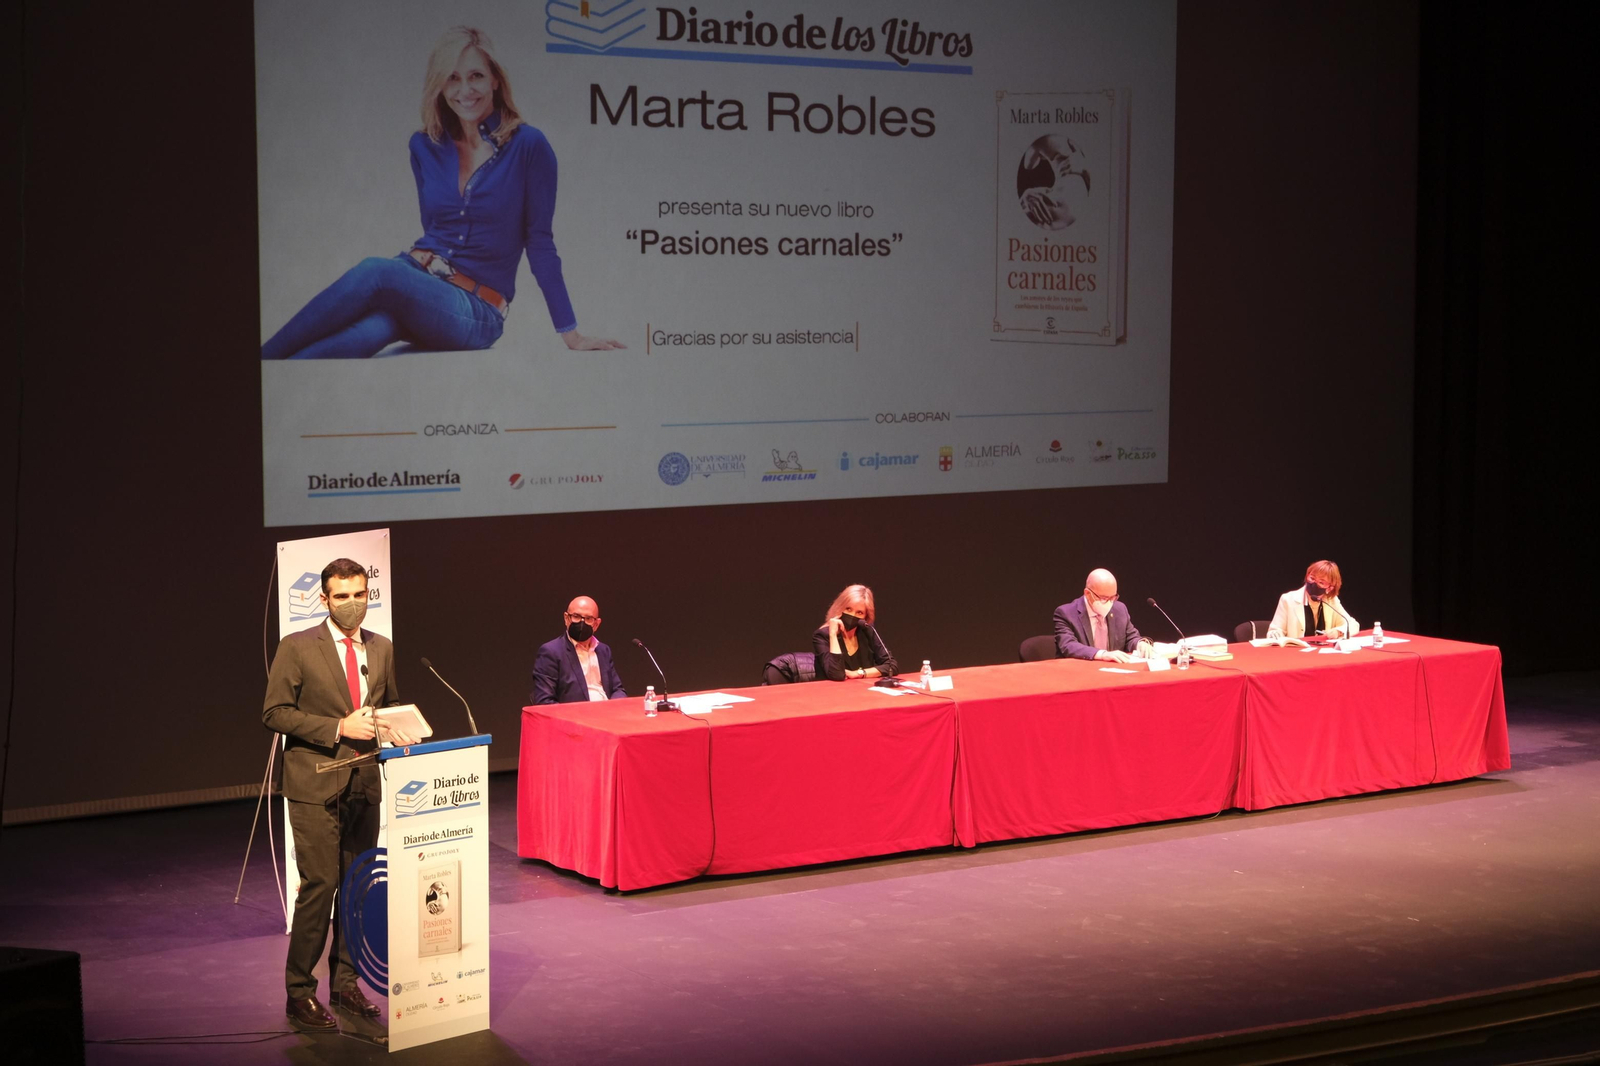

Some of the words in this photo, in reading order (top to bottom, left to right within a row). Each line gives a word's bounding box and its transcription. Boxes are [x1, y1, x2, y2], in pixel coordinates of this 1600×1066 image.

[656, 7, 778, 46] Diario
[782, 14, 827, 50] de
[831, 17, 875, 52] los
[881, 18, 973, 66] Libros
[589, 83, 748, 131] Marta
[766, 91, 936, 138] Robles
[1010, 108, 1050, 124] Marta
[1055, 107, 1099, 124] Robles
[658, 200, 743, 218] presenta
[748, 204, 770, 217] su
[775, 203, 832, 218] nuevo
[837, 201, 874, 218] libro
[626, 229, 769, 256] “Pasiones
[777, 232, 903, 257] carnales”
[1008, 237, 1097, 264] Pasiones
[1007, 266, 1097, 291] carnales
[652, 329, 715, 346] Gracias
[720, 332, 748, 348] por
[752, 331, 771, 345] su
[776, 329, 854, 345] asistencia
[875, 412, 950, 424] COLABORAN
[423, 424, 499, 437] ORGANIZA
[690, 454, 746, 463] UNIVERSIDAD
[965, 442, 1021, 458] ALMERÍA
[1117, 447, 1156, 461] Picasso
[691, 463, 703, 471] DE
[858, 452, 919, 470] cajamar
[308, 473, 365, 490] Diario
[367, 472, 388, 488] de
[390, 469, 460, 487] Almería
[761, 472, 816, 482] MICHELIN
[433, 774, 466, 790] Diario
[467, 773, 479, 784] de
[433, 794, 447, 806] los
[449, 790, 480, 807] Libros
[403, 832, 430, 845] Diario
[430, 830, 440, 840] de
[440, 825, 473, 839] Almería
[423, 873, 436, 881] Marta
[437, 870, 452, 878] Robles
[423, 917, 452, 930] Pasiones
[423, 927, 452, 939] carnales
[464, 968, 486, 977] cajamar
[405, 1002, 428, 1012] ALMERÍA
